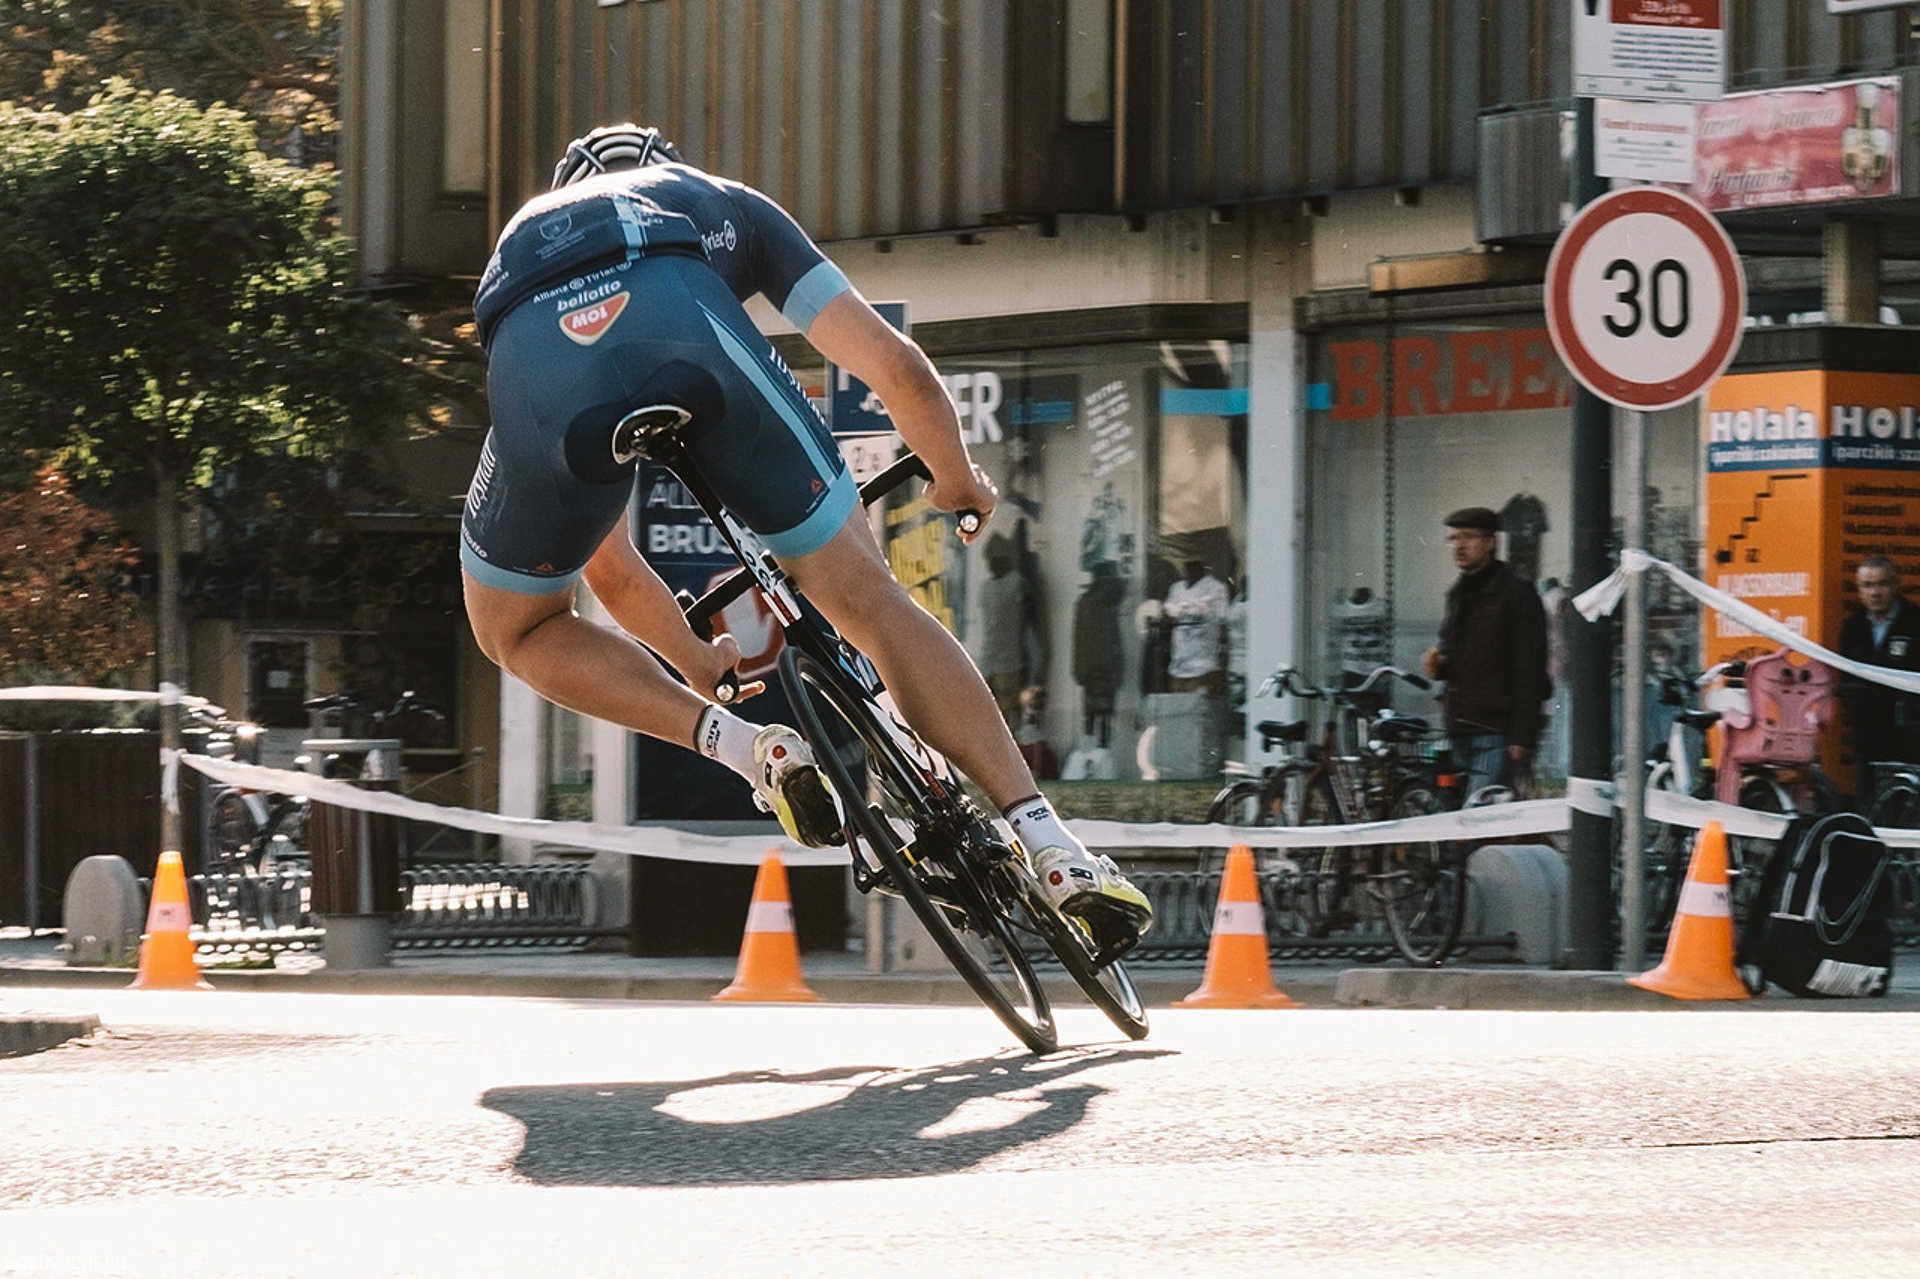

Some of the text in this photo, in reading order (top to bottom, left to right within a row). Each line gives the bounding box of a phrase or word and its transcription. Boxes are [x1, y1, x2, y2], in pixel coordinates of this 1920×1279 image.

[556, 280, 622, 312] bellotto
[1603, 258, 1690, 338] 30
[571, 305, 609, 330] MOL
[1330, 329, 1574, 423] BREE
[942, 371, 1003, 445] ER
[1710, 404, 1817, 442] Holala
[1831, 405, 1920, 440] Hol
